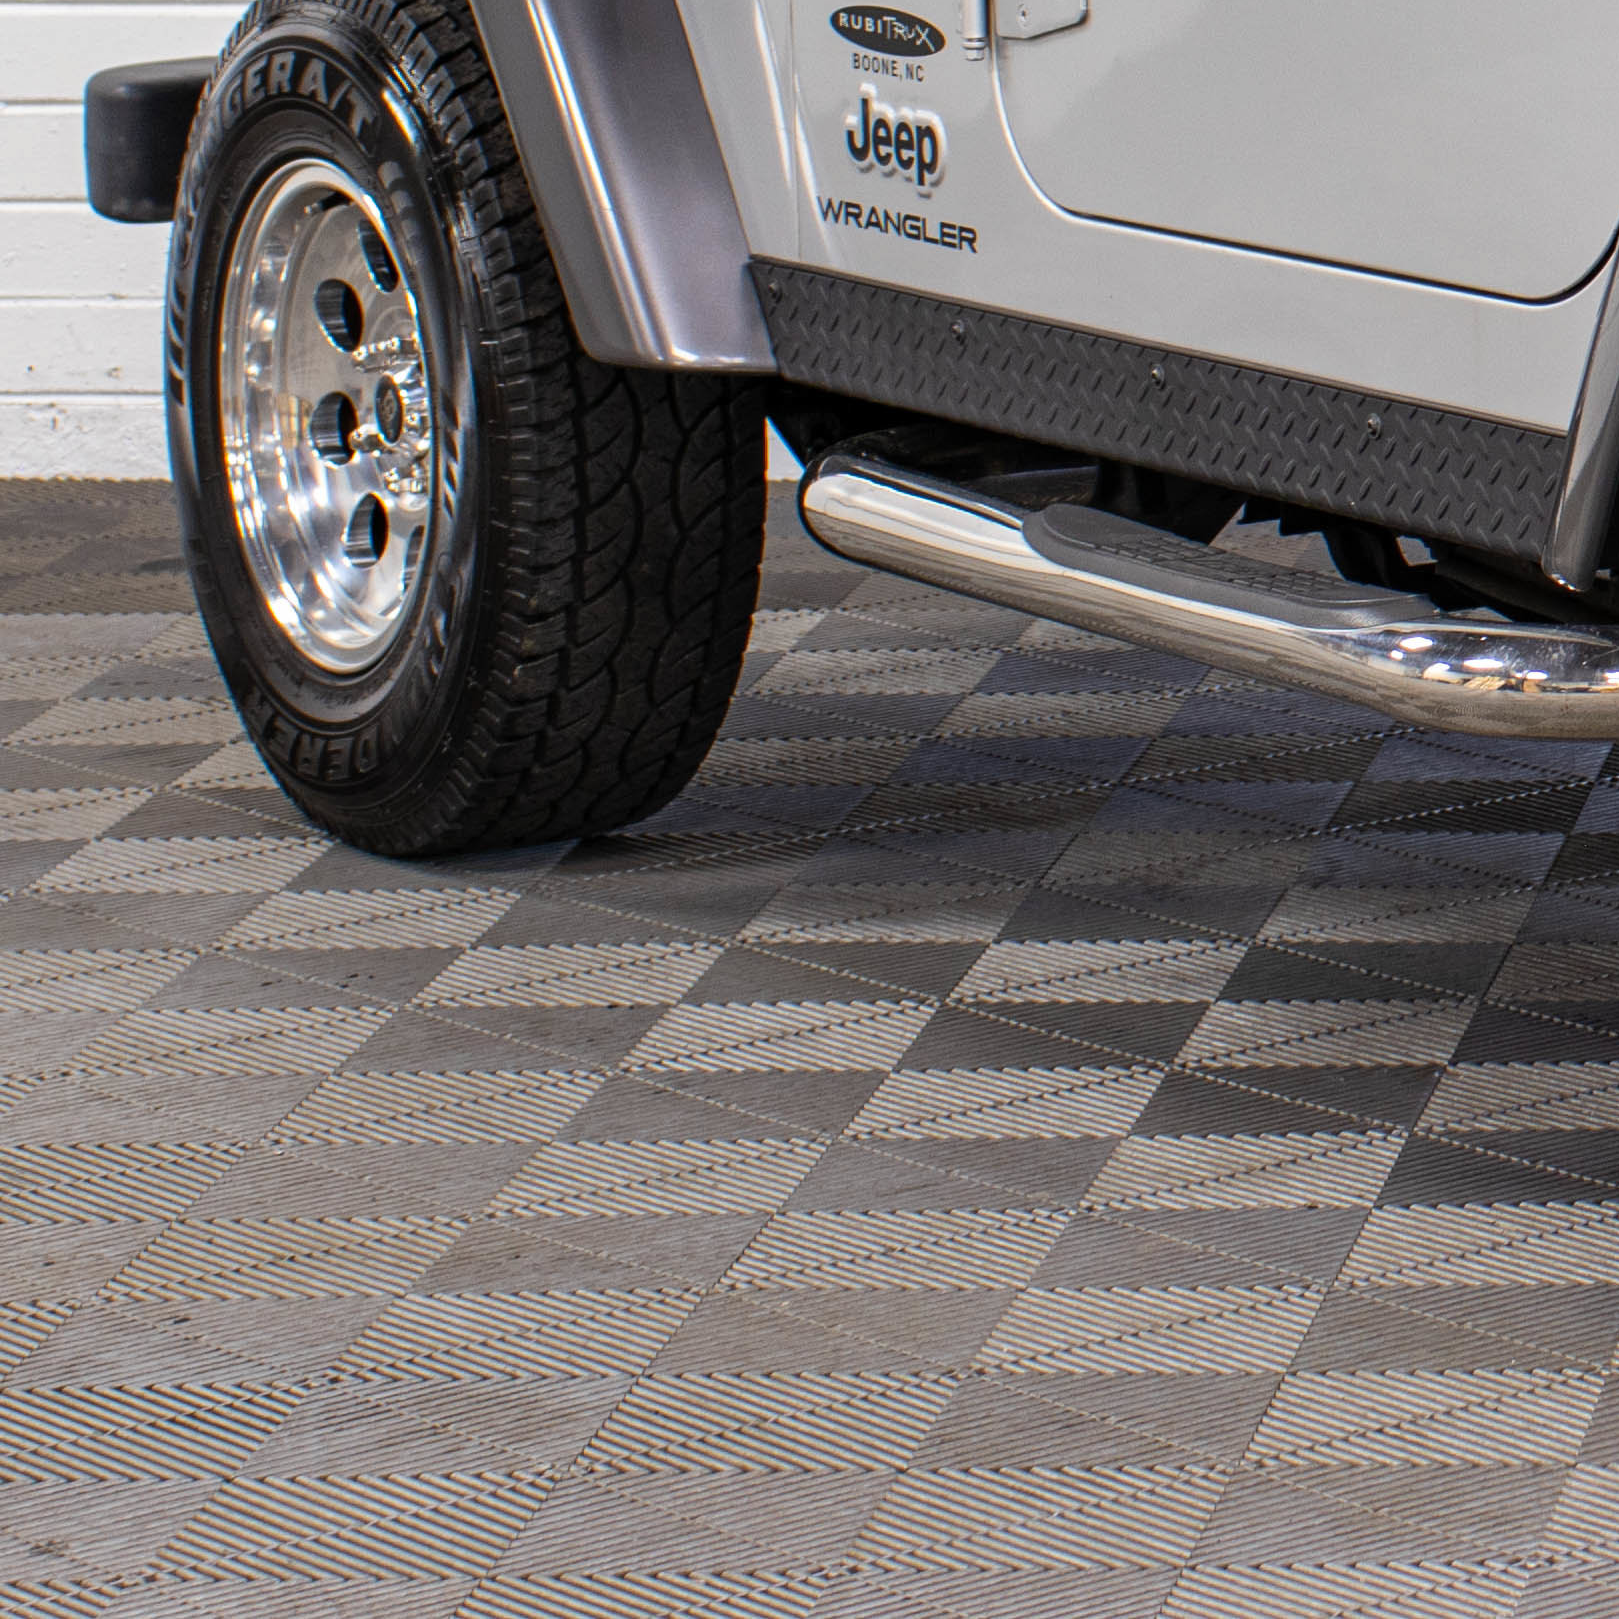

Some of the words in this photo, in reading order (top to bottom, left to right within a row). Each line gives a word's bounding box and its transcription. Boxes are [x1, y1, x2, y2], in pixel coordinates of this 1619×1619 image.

[905, 62, 924, 82] NC
[846, 91, 943, 189] Jeep
[816, 195, 978, 254] WRANGLER
